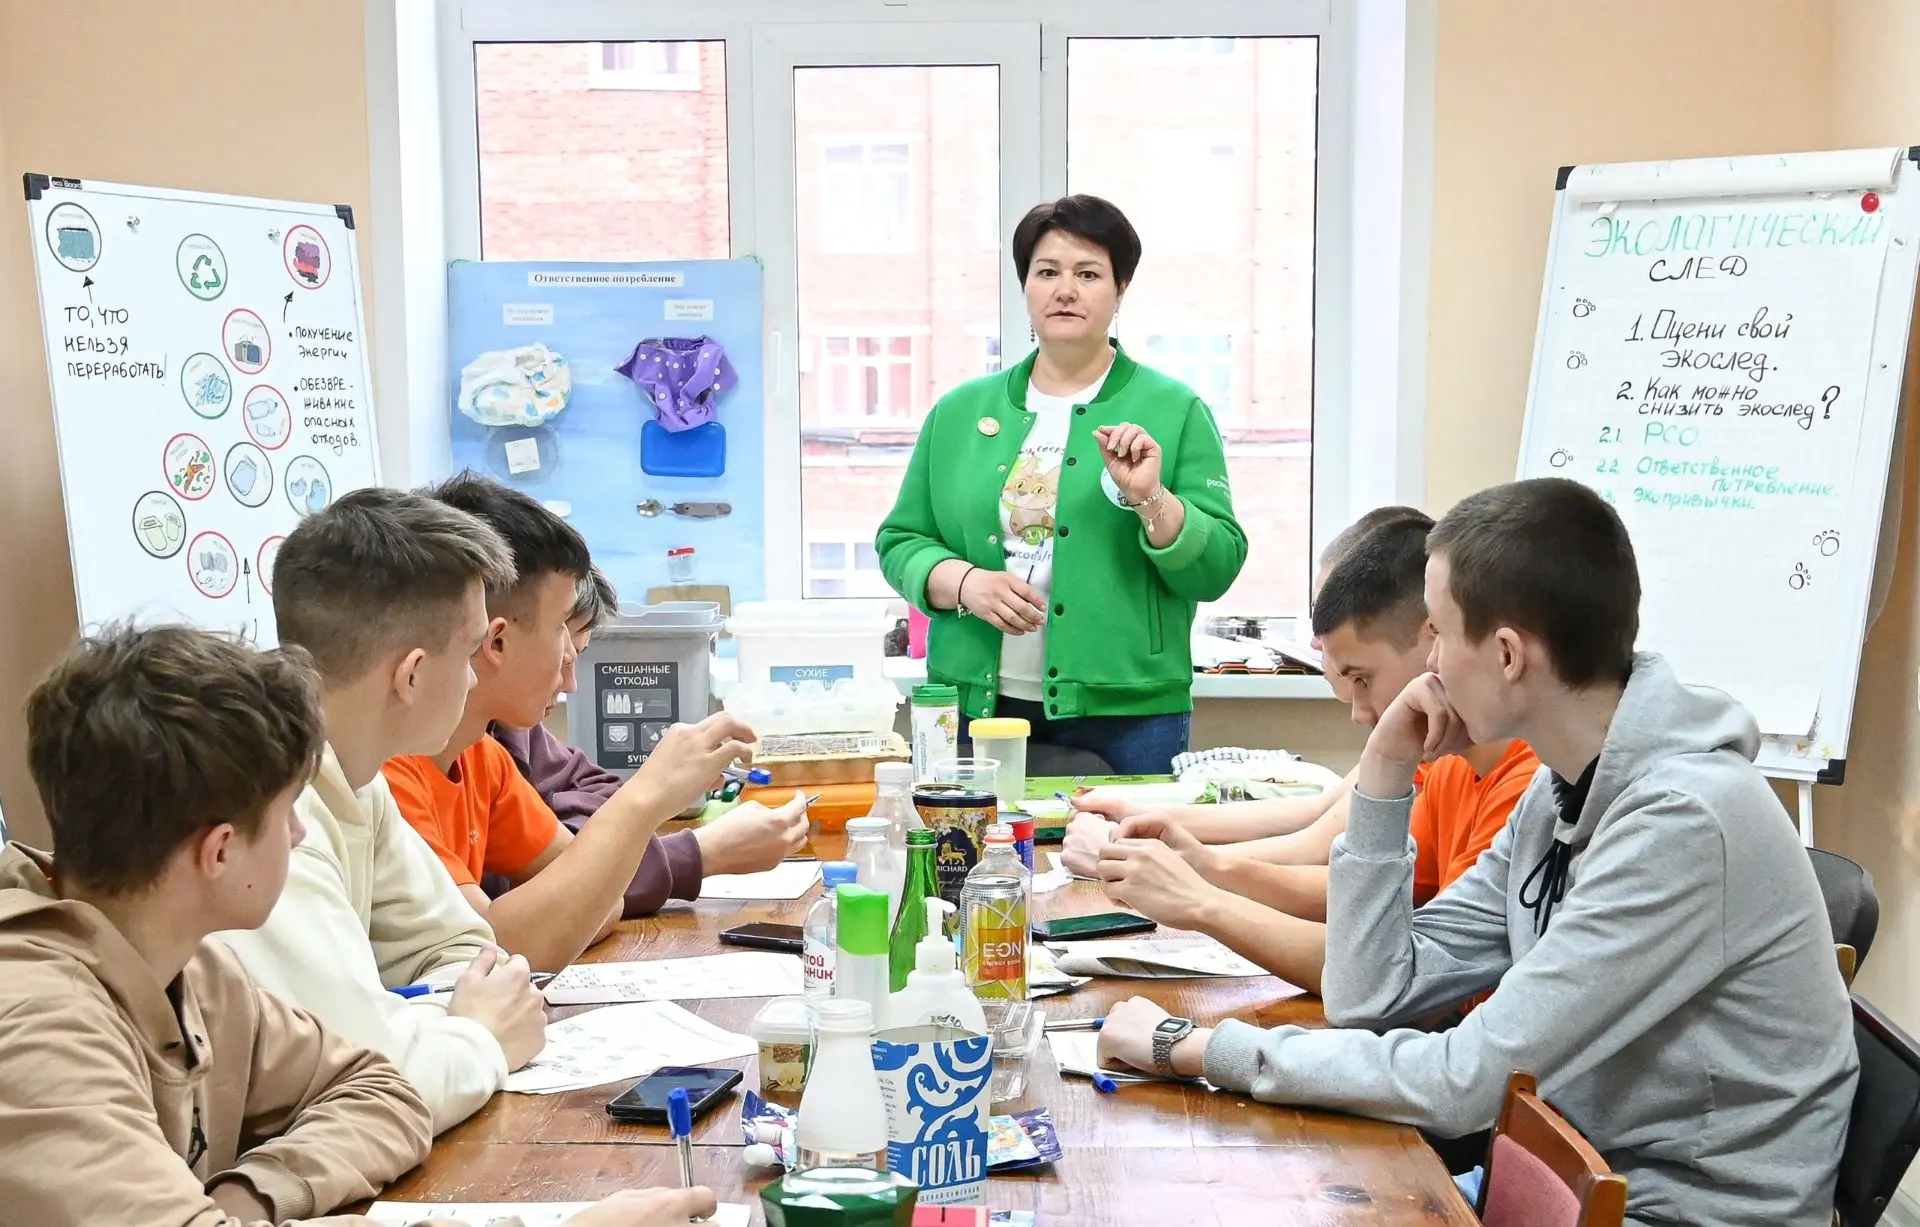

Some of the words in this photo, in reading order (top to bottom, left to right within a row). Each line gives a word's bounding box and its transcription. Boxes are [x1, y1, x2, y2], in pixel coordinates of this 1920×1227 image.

[1584, 208, 1886, 257] ЭКОЛОГИЧЕСКИЙ
[534, 273, 610, 283] Ответственное
[612, 274, 677, 285] потребление
[1649, 255, 1748, 282] СЛЕД
[97, 306, 130, 326] ЧТО
[1650, 308, 1727, 347] Оцени
[1737, 306, 1793, 339] свой
[64, 335, 130, 357] НЕЛЬЗЯ
[1616, 381, 1635, 401] 2.
[1644, 376, 1680, 401] Как
[1691, 384, 1759, 401] можно
[1637, 402, 1725, 417] снизить
[1644, 422, 1700, 447] РСО
[1636, 456, 1780, 480] Ответственное
[601, 665, 671, 675] СМЕШАННЫЕ
[795, 668, 829, 678] СУХИЕ
[614, 676, 658, 687] ОТХОДЫ
[936, 865, 968, 873] RICHARD
[804, 953, 824, 968] ТОЙ
[911, 1131, 981, 1188] СОЛЬ
